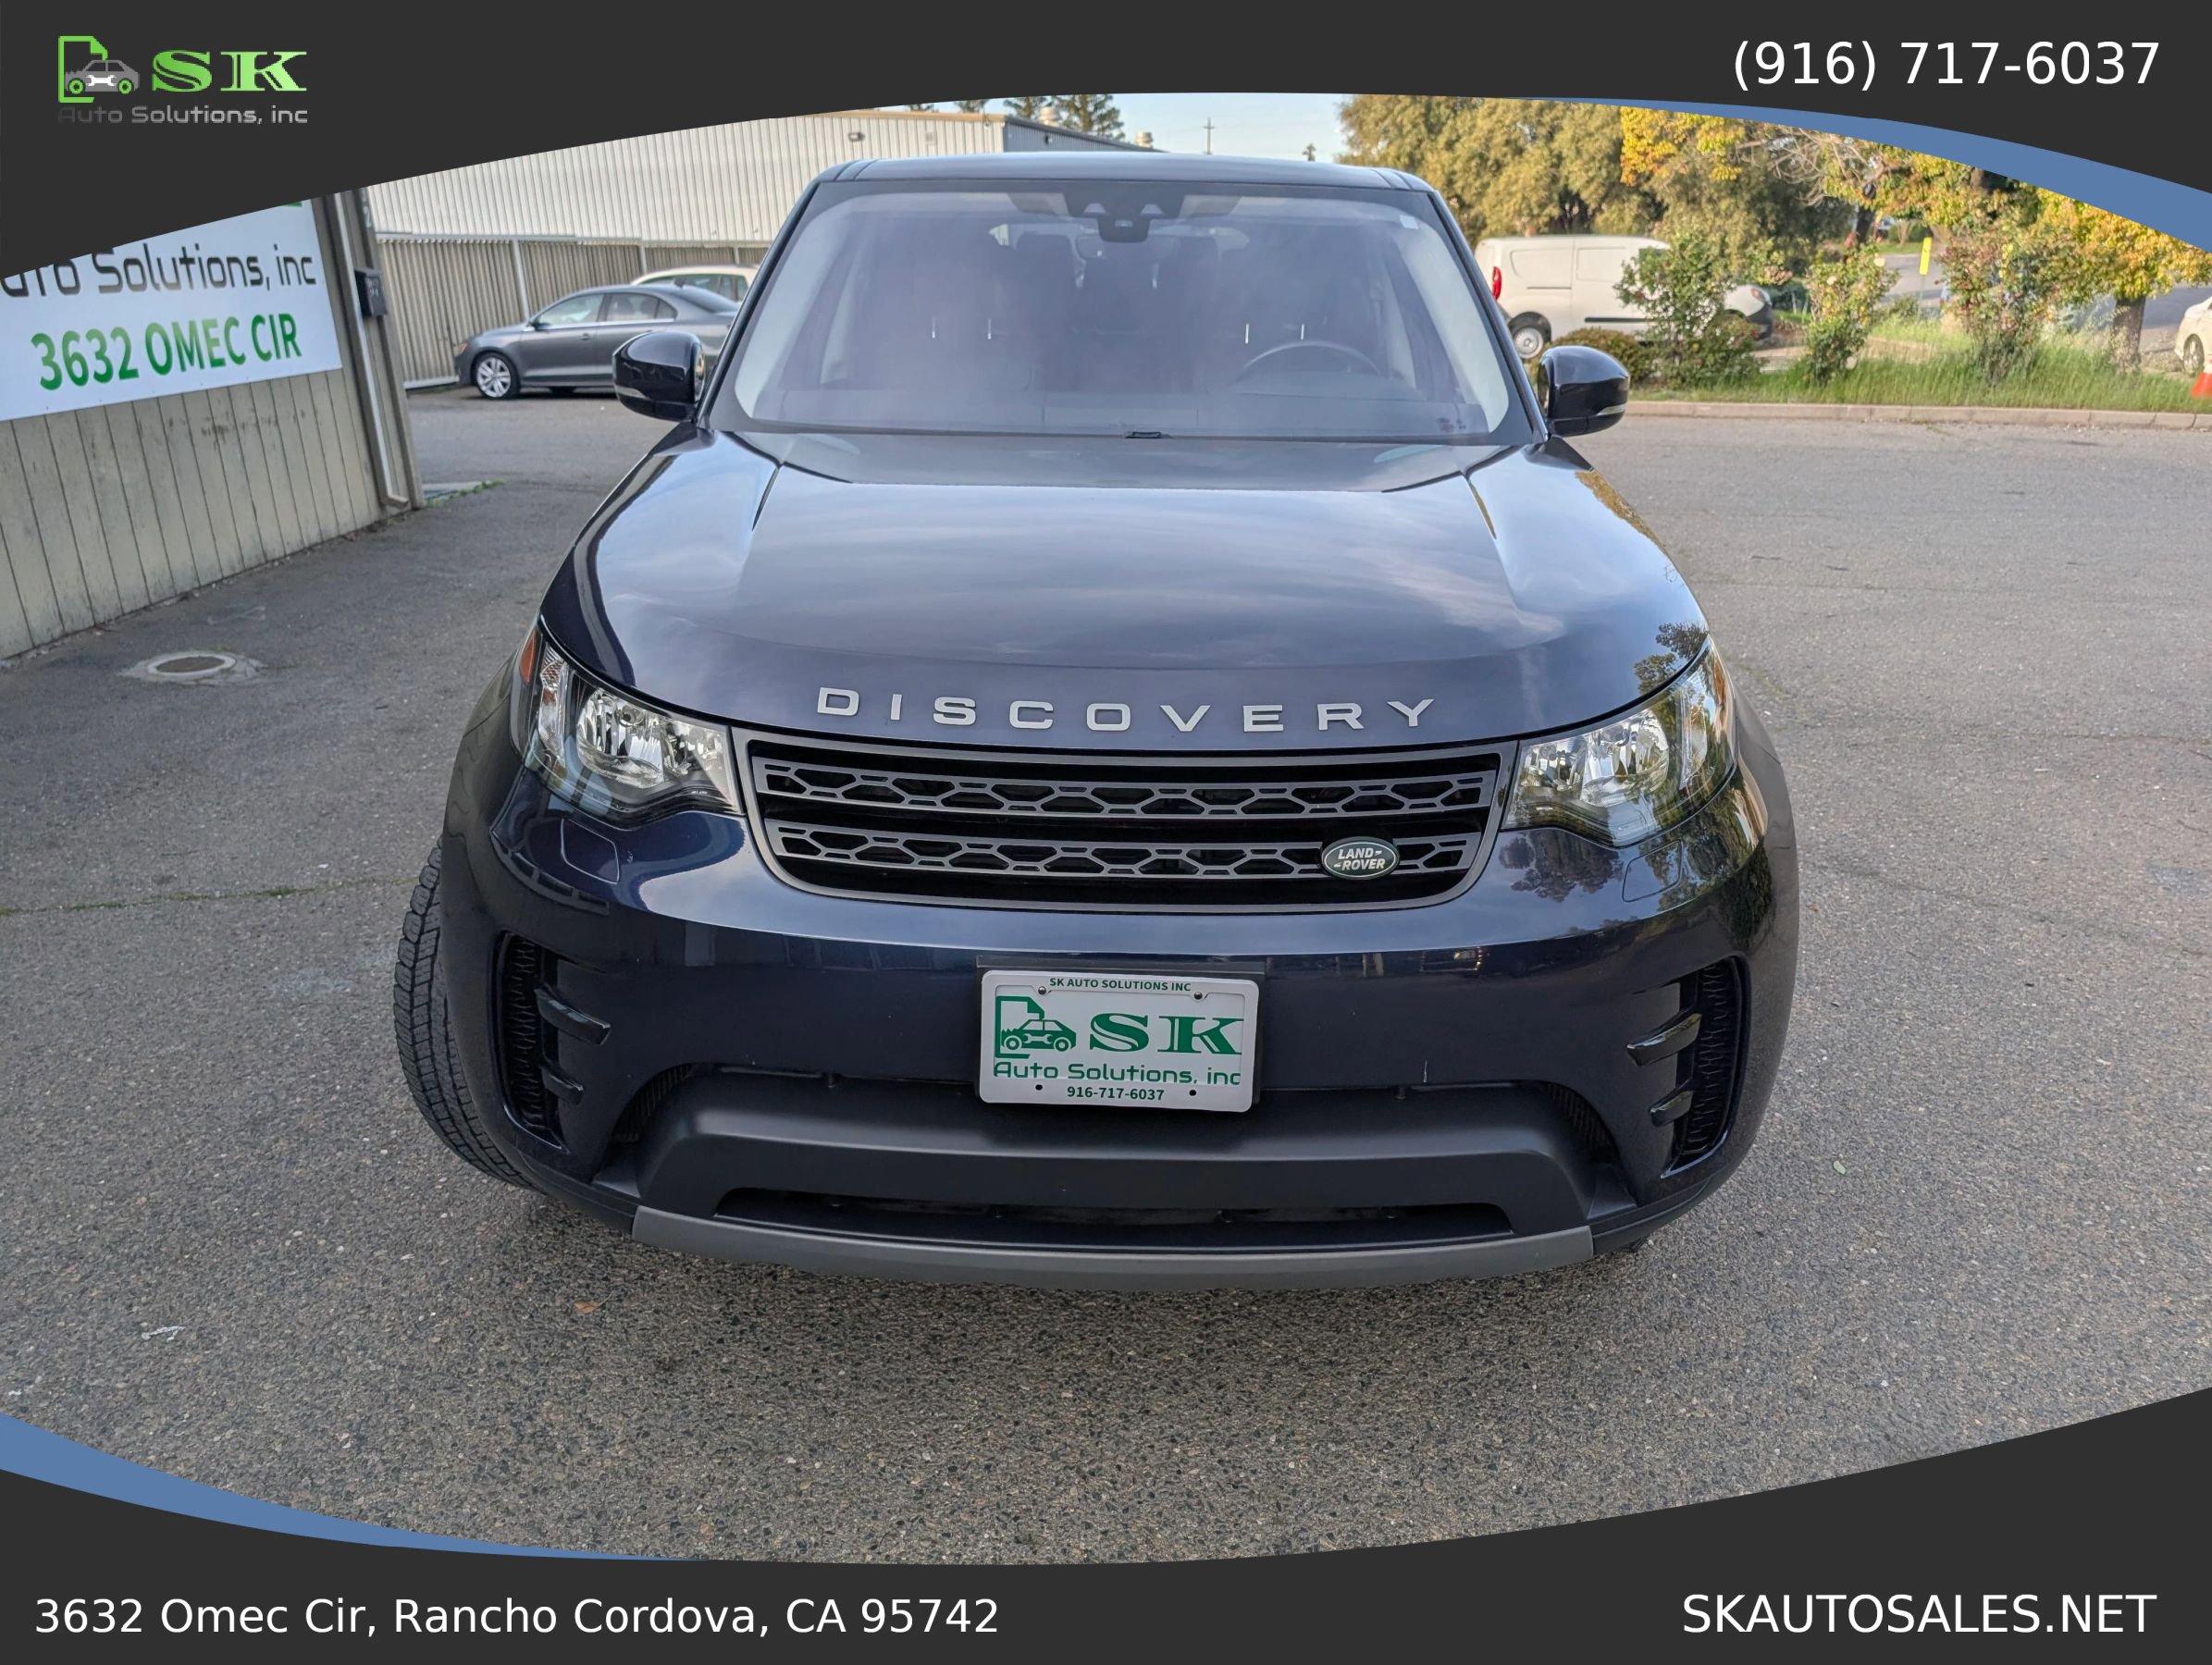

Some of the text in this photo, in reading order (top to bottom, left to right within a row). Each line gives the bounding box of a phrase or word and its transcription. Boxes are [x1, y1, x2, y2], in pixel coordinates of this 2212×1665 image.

[0, 242, 317, 298] uto Solutions, inc
[31, 313, 303, 391] 3632 OMEC CIR
[816, 685, 1435, 733] DISCOVERY
[1049, 977, 1192, 993] SK AUTO SOLUTIONS INC
[1089, 1012, 1245, 1055] SK
[993, 1061, 1242, 1086] Auto Solutions, inc
[1067, 1085, 1165, 1101] 916-717-6037
